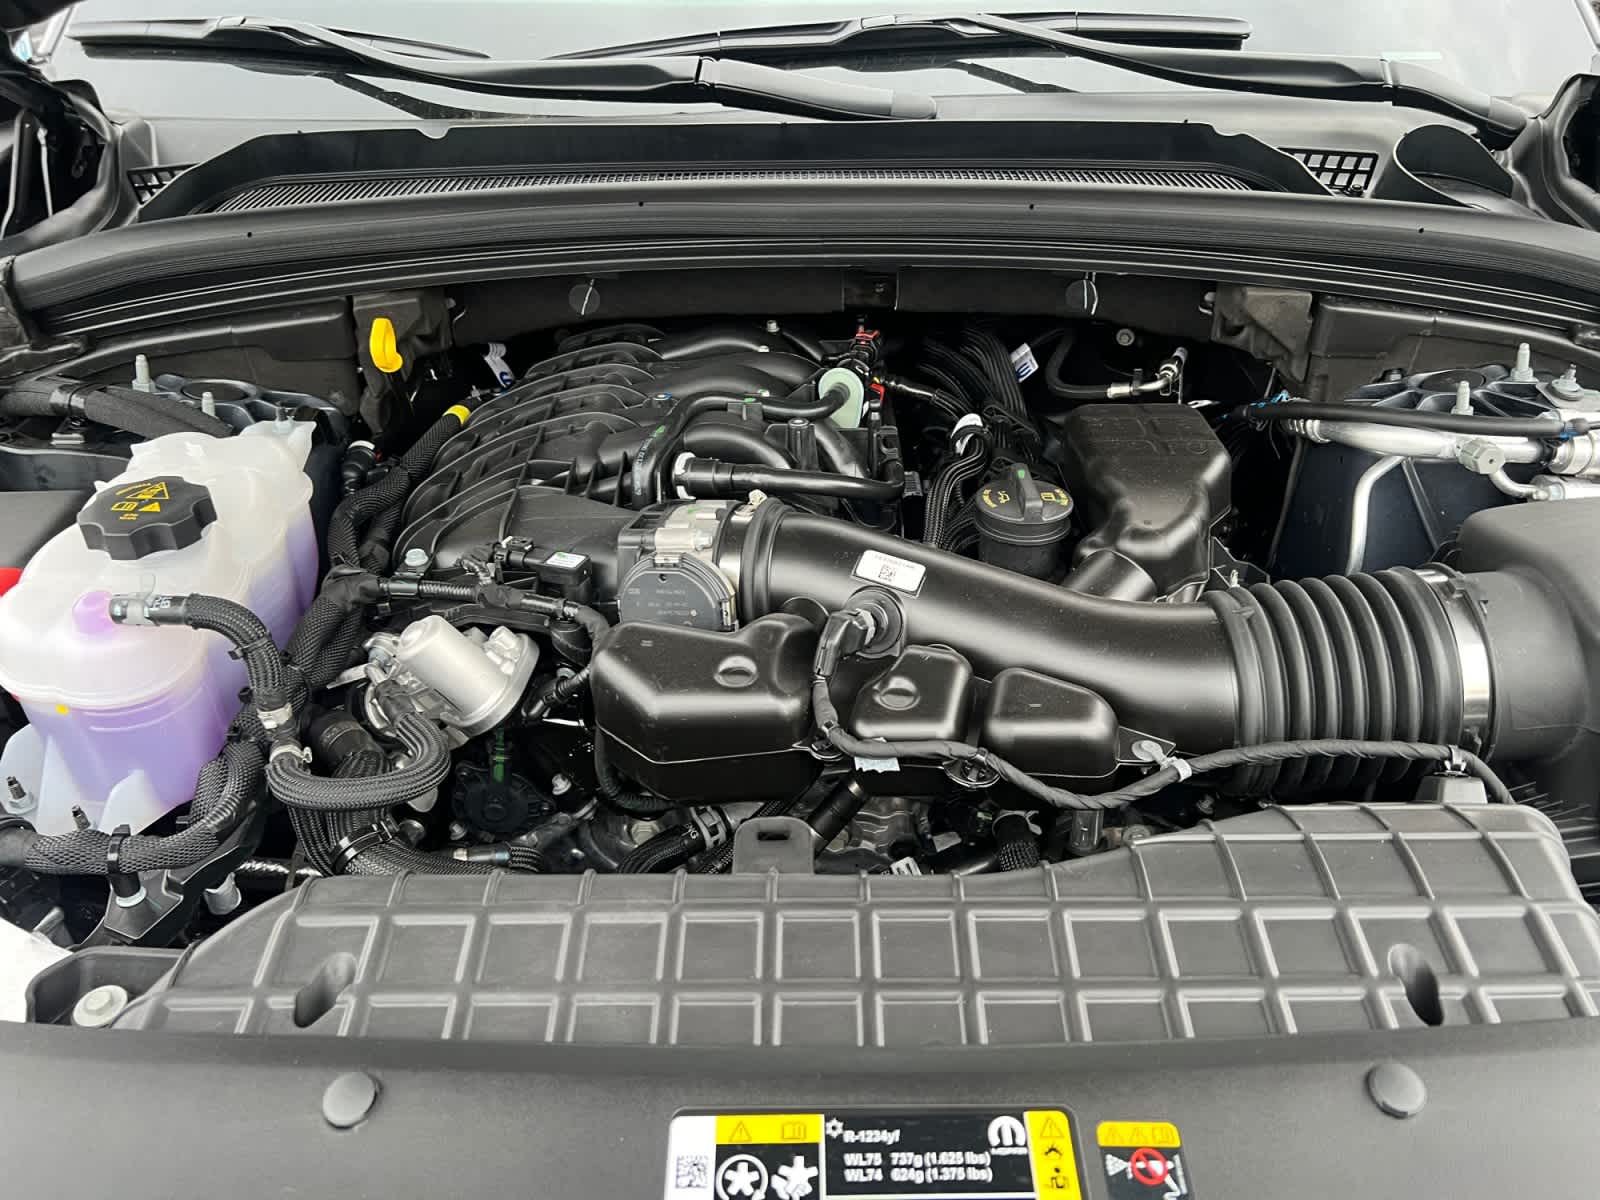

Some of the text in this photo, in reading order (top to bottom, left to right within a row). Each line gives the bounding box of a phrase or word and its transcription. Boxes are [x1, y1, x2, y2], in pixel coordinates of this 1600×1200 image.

[843, 1129, 901, 1145] R-1234yf
[844, 1152, 882, 1167] WL75
[890, 1152, 923, 1168] 737g
[965, 1151, 991, 1168] lbs)
[844, 1167, 993, 1184] WL74 624g (1.375 lbs)
